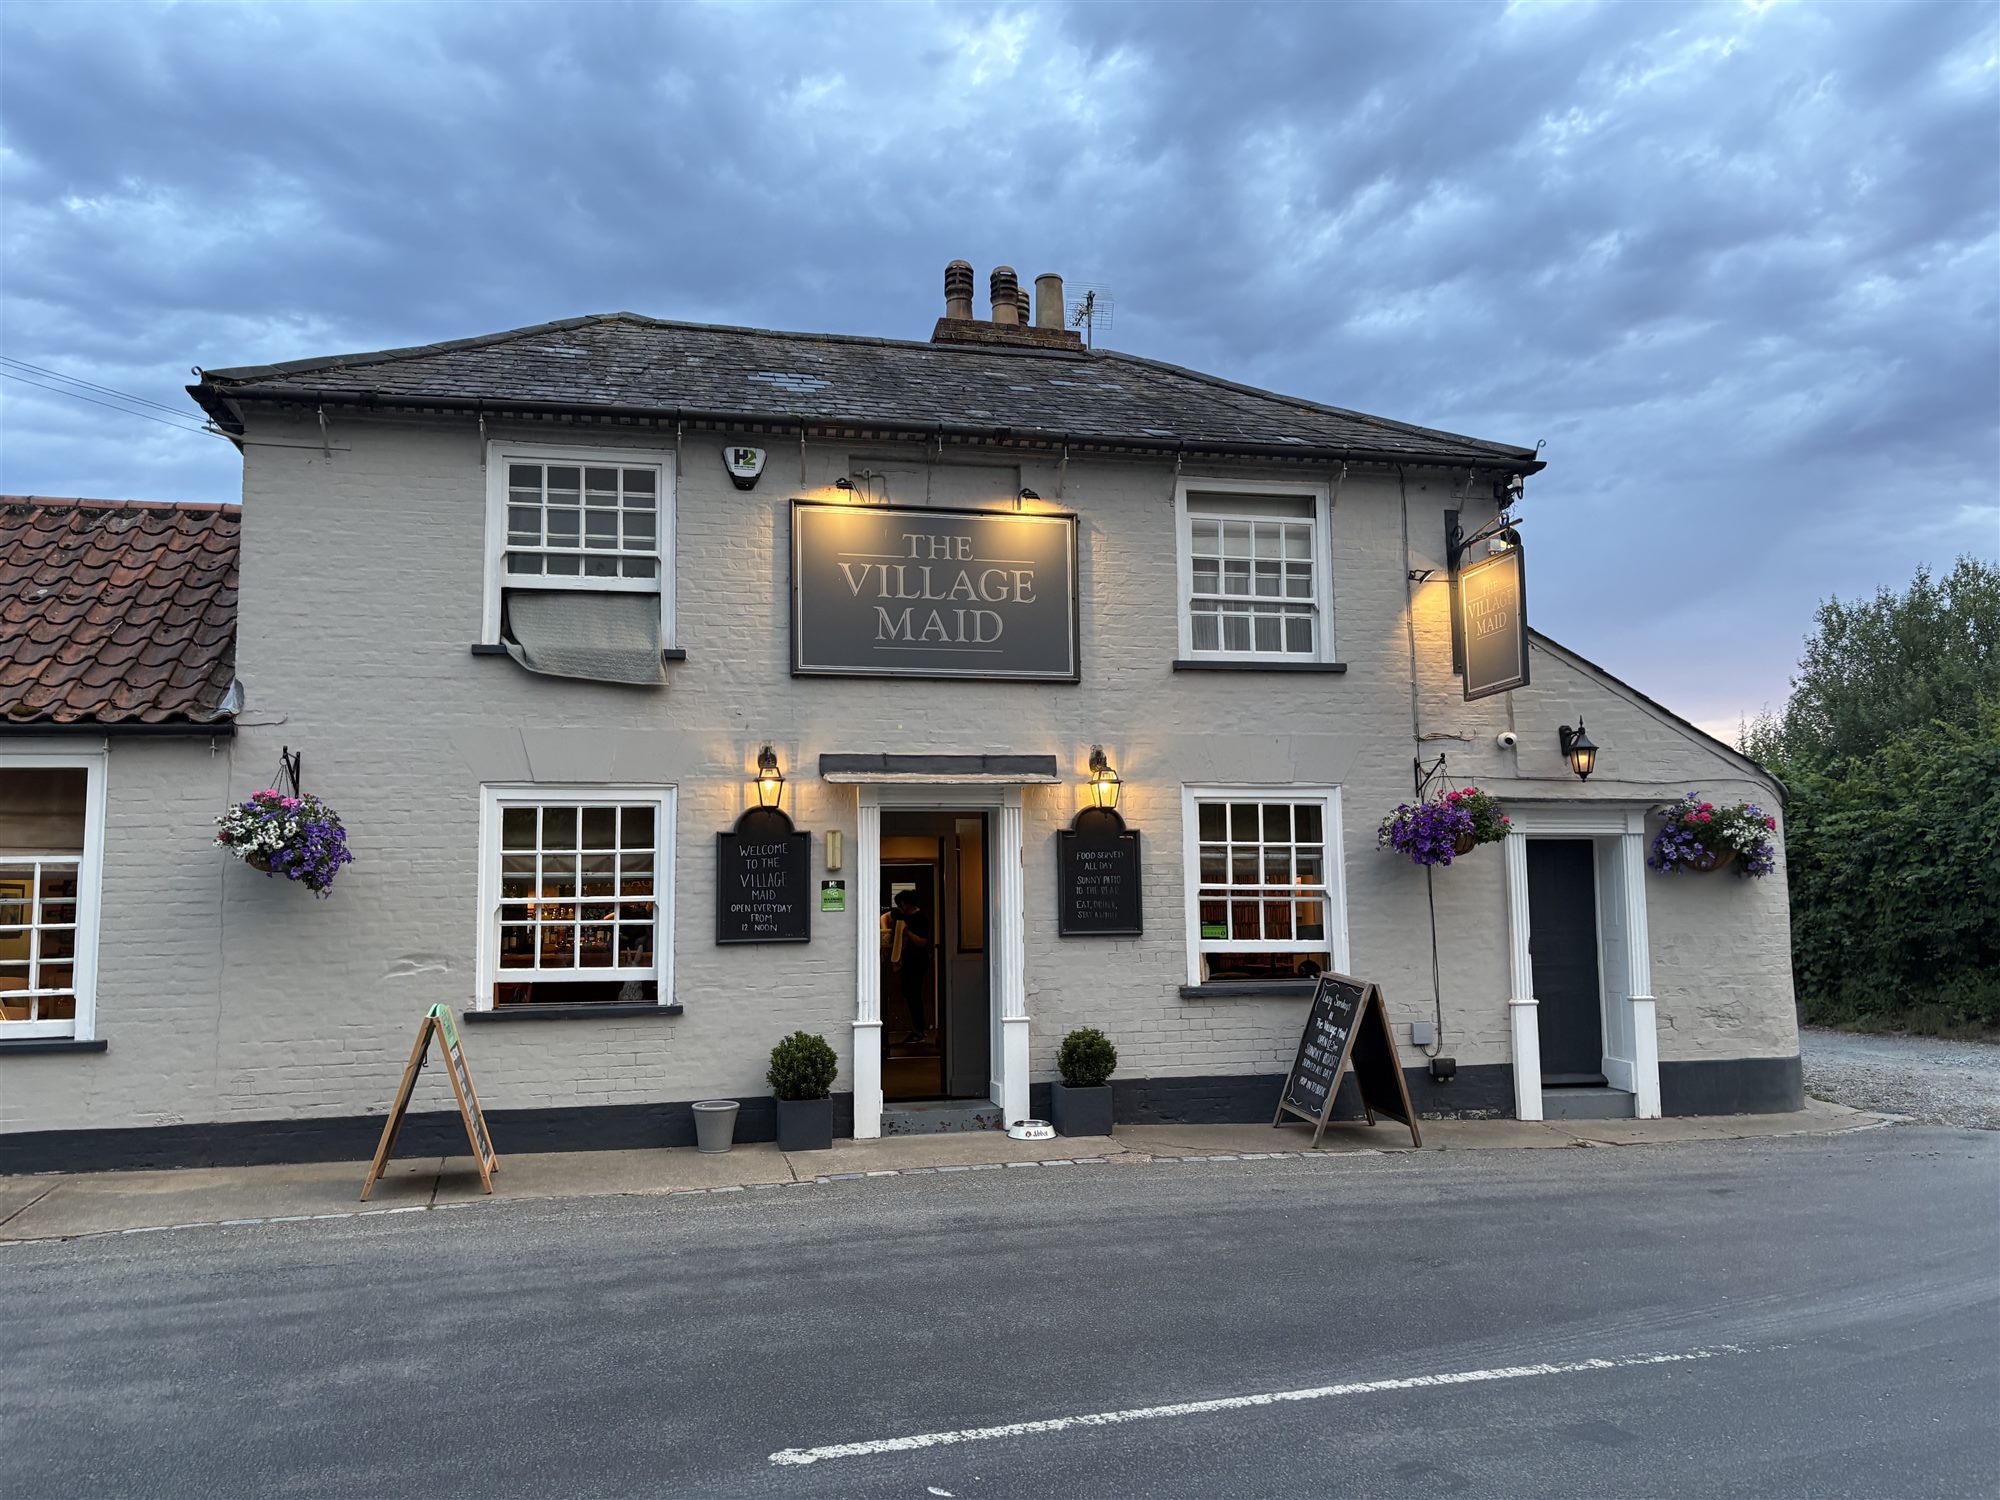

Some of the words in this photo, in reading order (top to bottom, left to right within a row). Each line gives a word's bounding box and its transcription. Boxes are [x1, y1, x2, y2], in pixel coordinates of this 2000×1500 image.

[734, 449, 757, 466] H2
[902, 533, 975, 561] THE
[837, 562, 1037, 604] VILLAGE
[1482, 580, 1498, 597] THE
[1468, 588, 1514, 619] VILLAGE
[873, 606, 1004, 643] MAID
[1476, 612, 1507, 636] MAID
[739, 843, 789, 857] WELCOME
[1076, 851, 1096, 860] FOOD
[746, 859, 758, 870] TO
[761, 857, 780, 868] THE
[1084, 862, 1098, 870] ALL
[1099, 862, 1113, 870] DAY
[740, 872, 788, 888] VILLAGE
[1077, 875, 1102, 885] SUNNY
[751, 889, 777, 901] MAID
[731, 904, 751, 913] OPEN
[753, 904, 793, 913] EVERYDAY
[750, 913, 773, 924] FROM
[741, 923, 748, 932] 12
[754, 924, 778, 932] NOON
